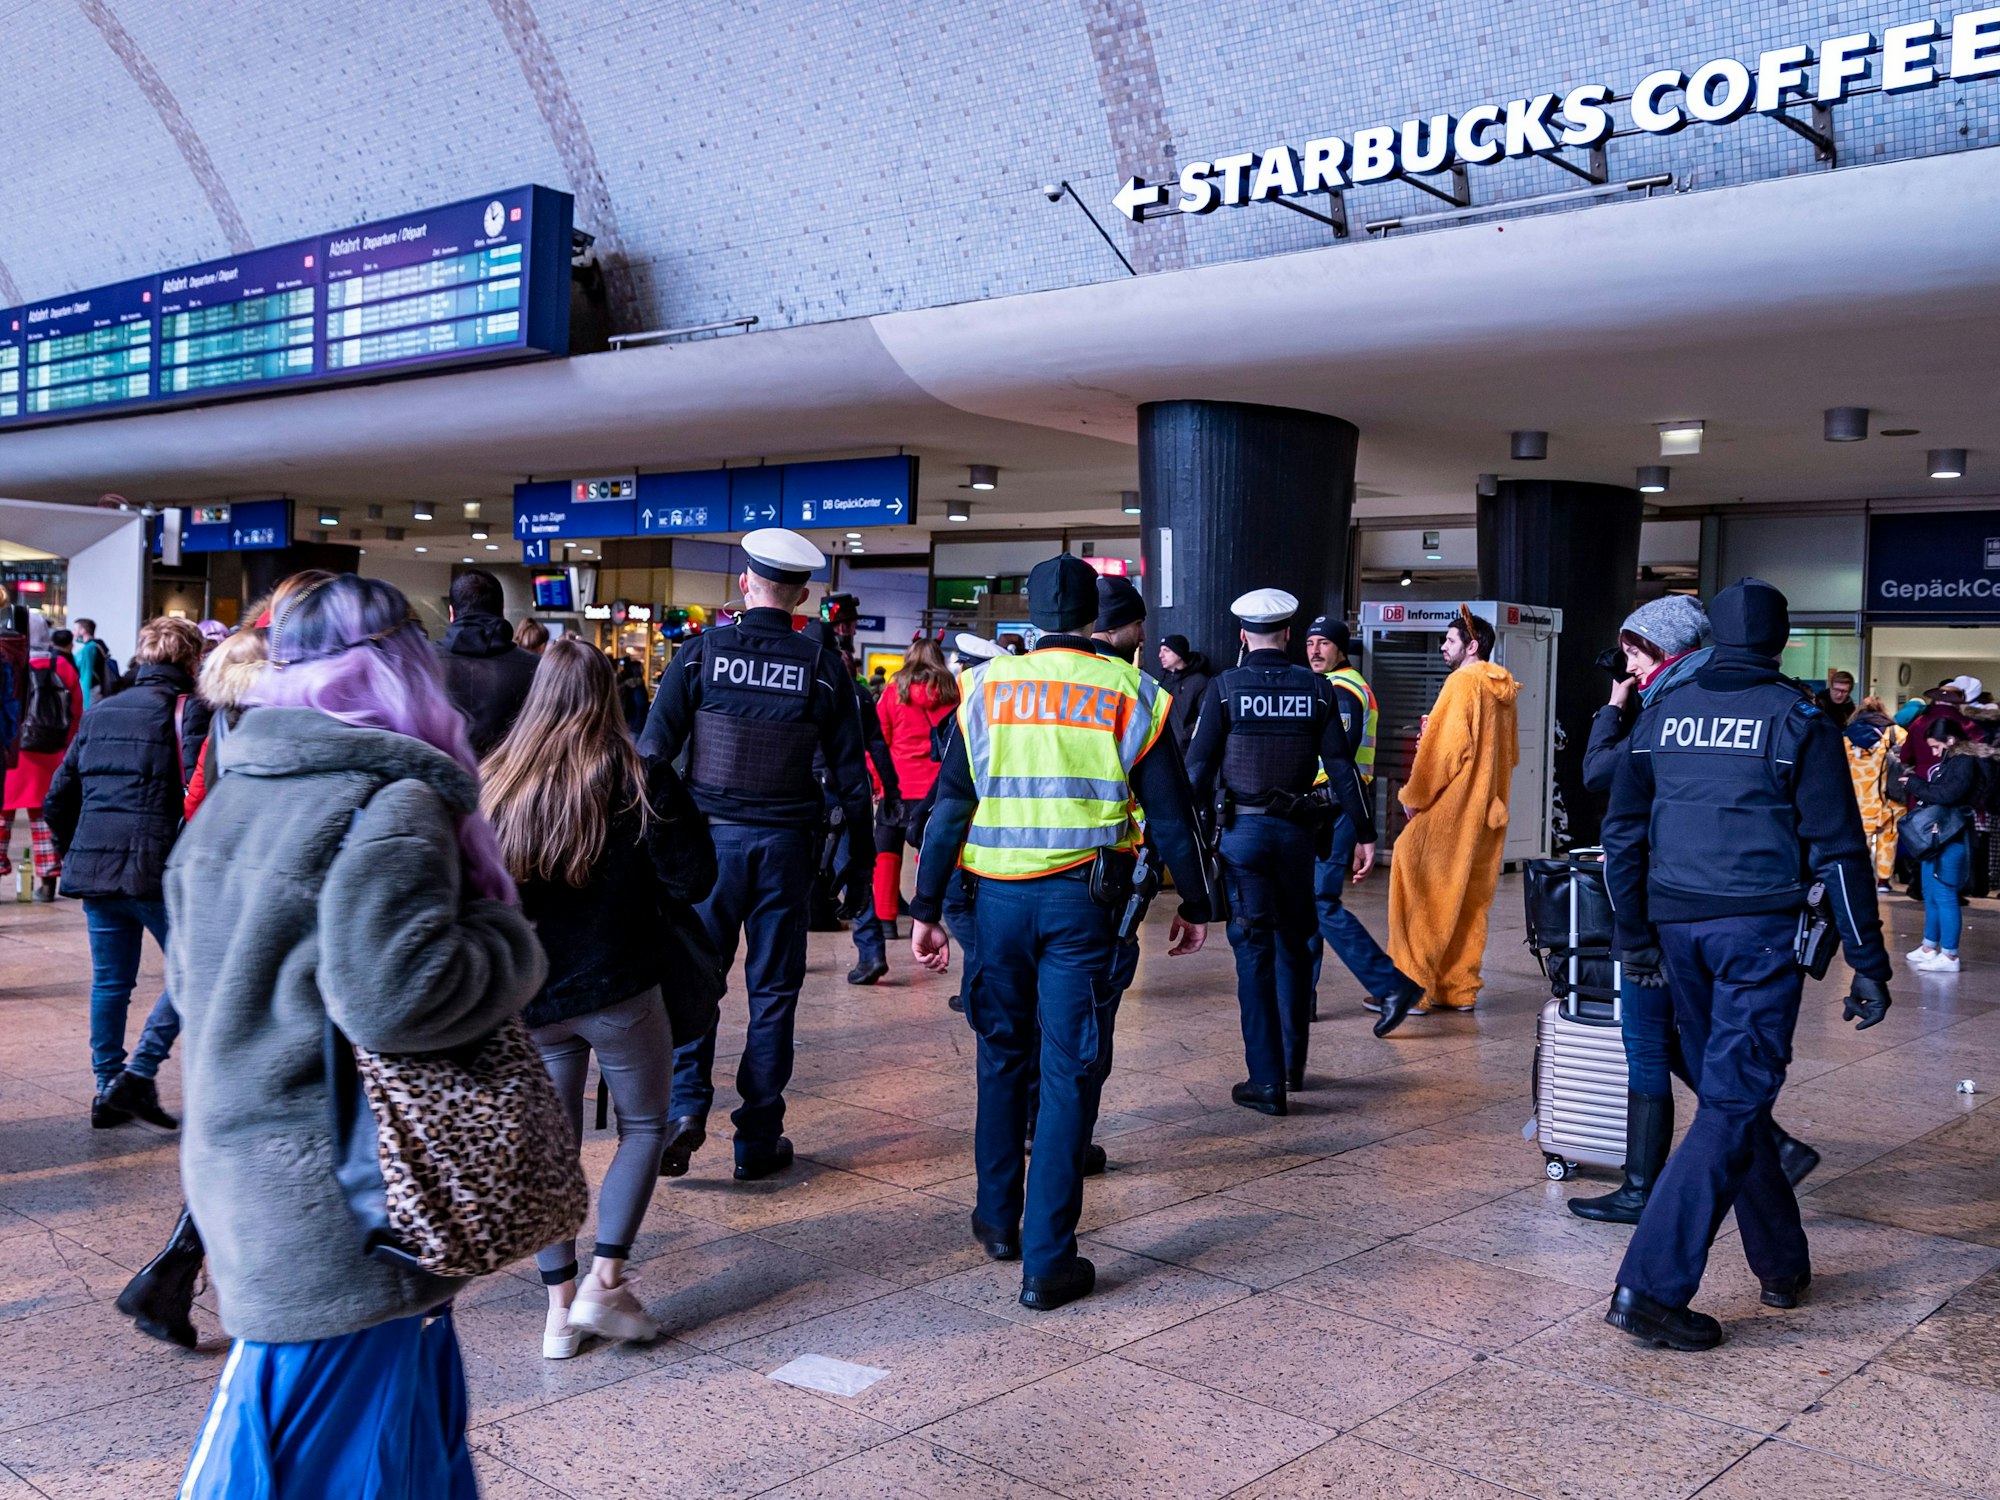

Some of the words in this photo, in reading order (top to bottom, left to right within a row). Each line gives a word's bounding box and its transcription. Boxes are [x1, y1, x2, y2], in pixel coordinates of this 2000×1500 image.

[1178, 84, 1613, 213] STARBUCKS
[1630, 8, 2000, 134] COFFEE
[329, 237, 361, 257] Abfahrt
[363, 232, 397, 251] Departure
[402, 224, 427, 241] Départ
[823, 500, 833, 510] DB
[834, 497, 881, 511] GepäckCenter
[537, 540, 543, 556] 1
[1385, 607, 1403, 620] DB
[713, 656, 805, 691] POLIZEI
[1240, 695, 1312, 717] POLIZEI
[1660, 717, 1763, 750] POLIZEI
